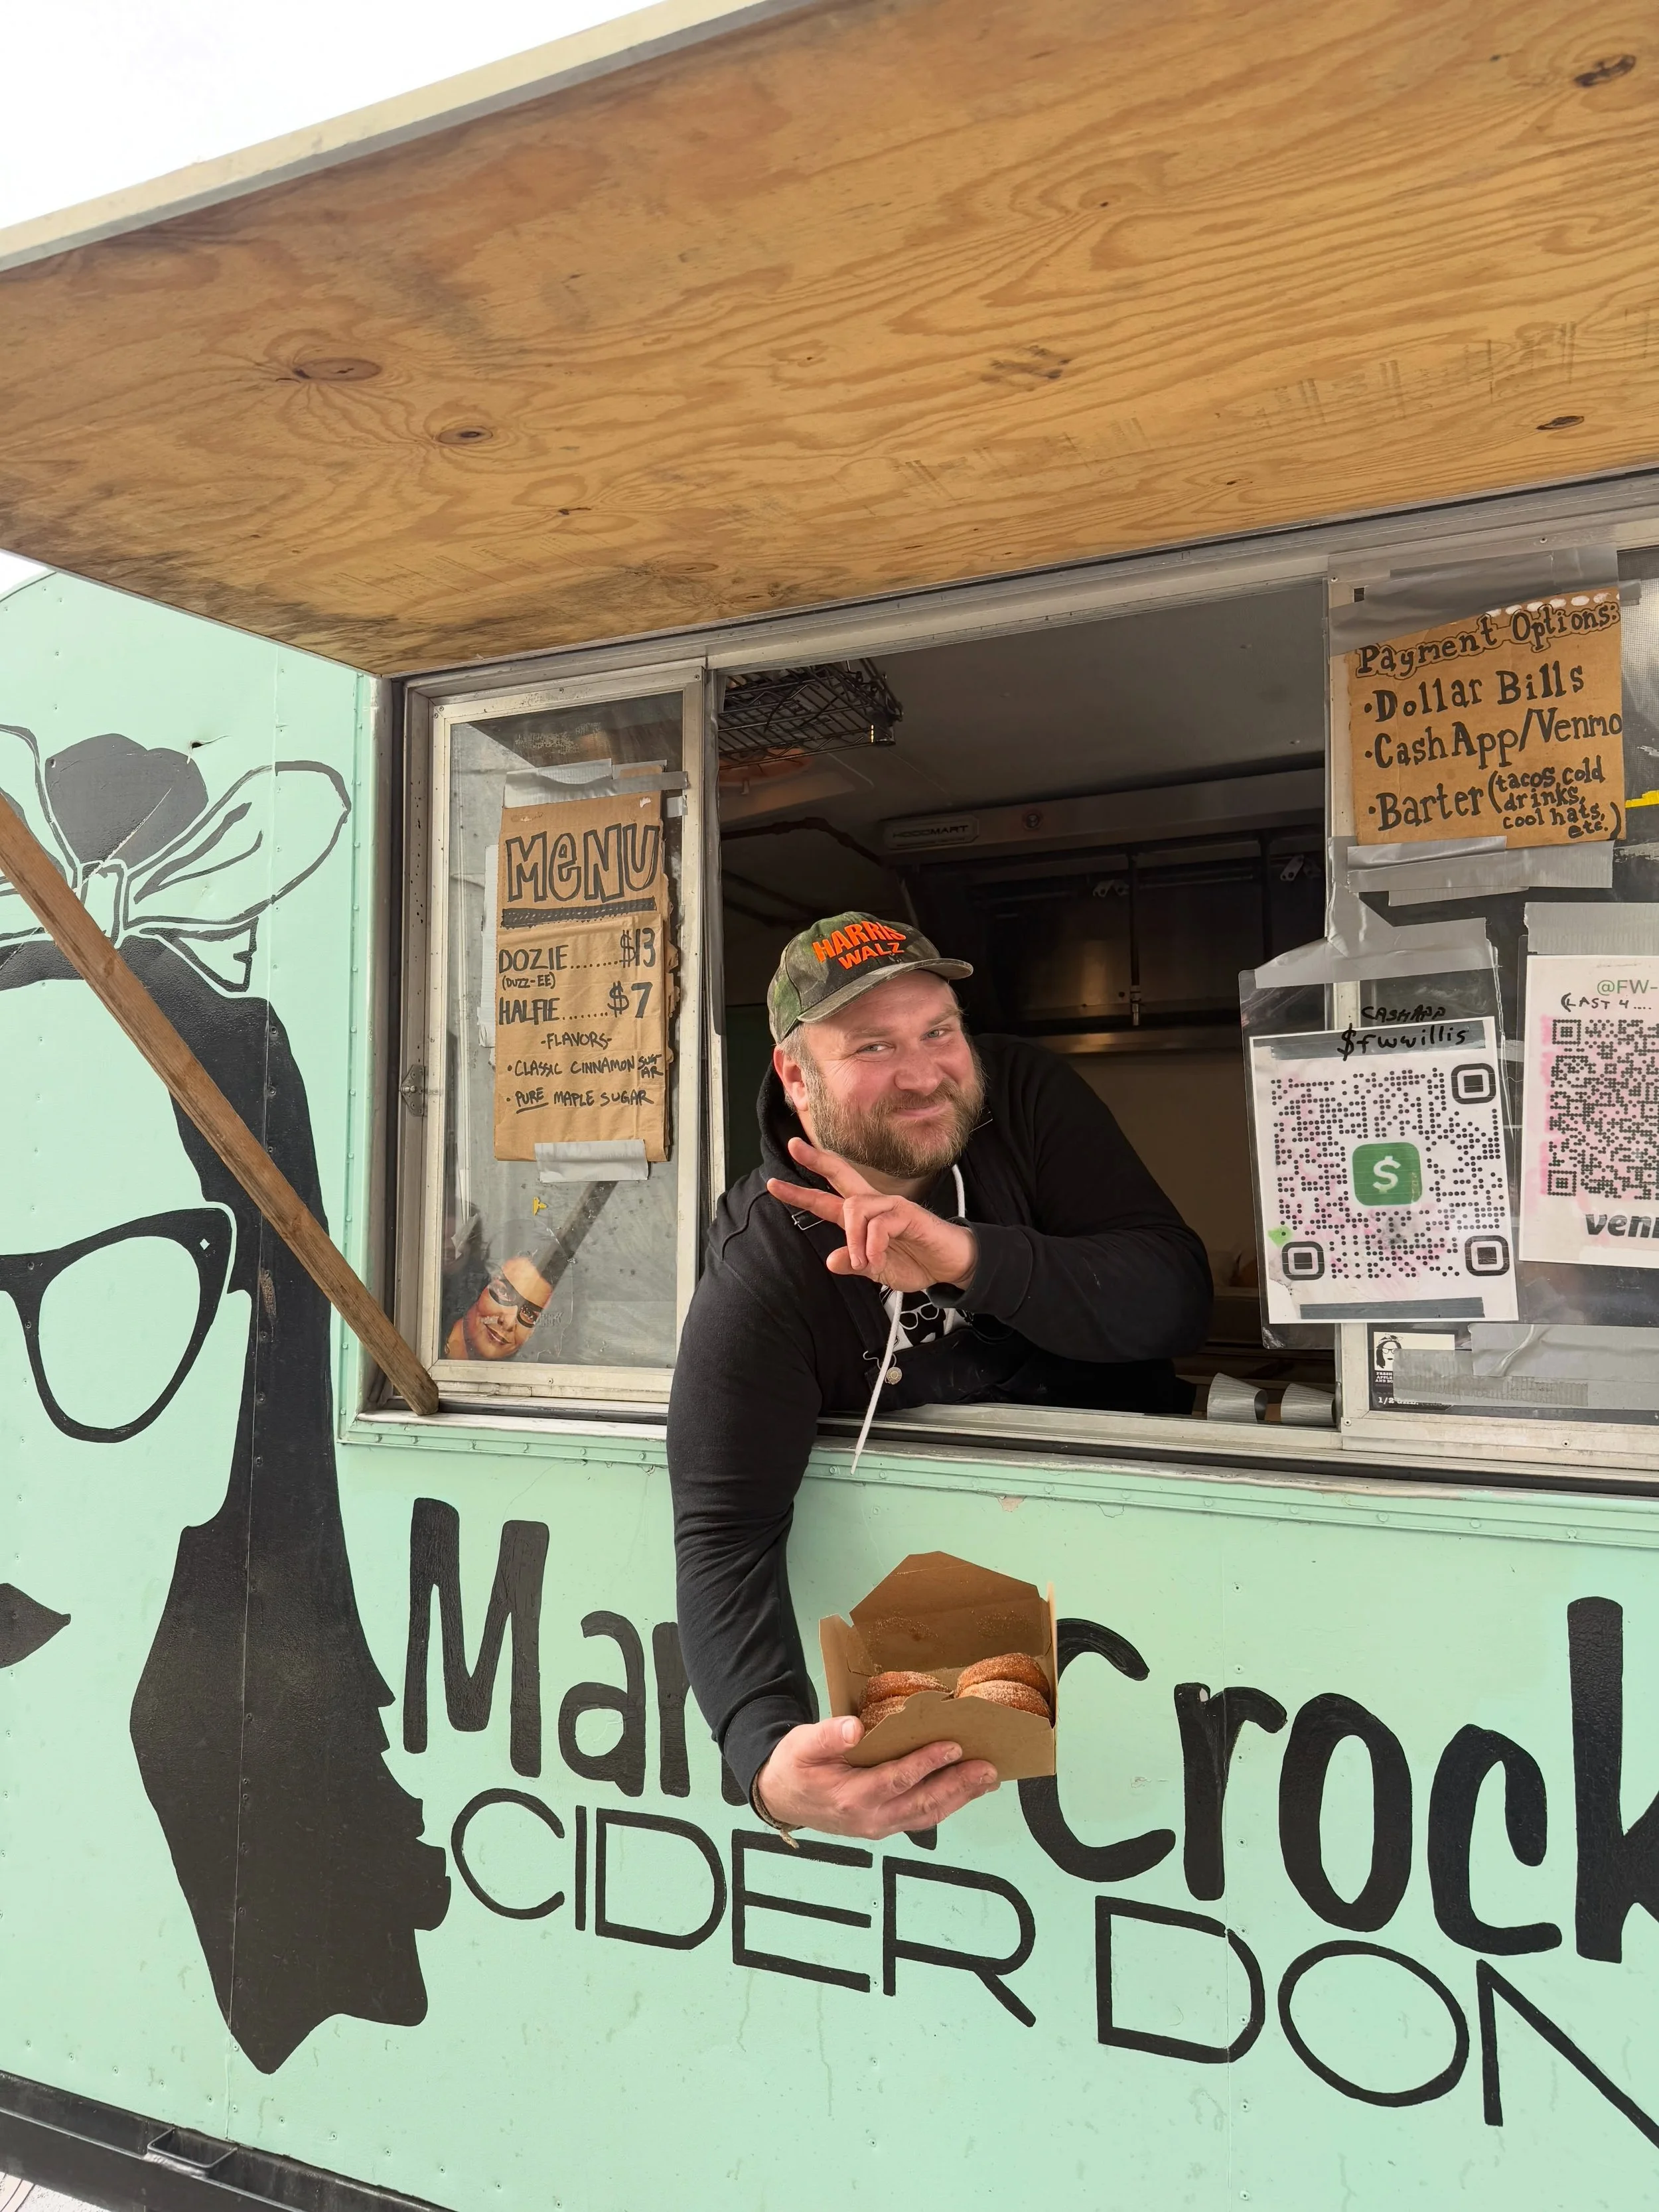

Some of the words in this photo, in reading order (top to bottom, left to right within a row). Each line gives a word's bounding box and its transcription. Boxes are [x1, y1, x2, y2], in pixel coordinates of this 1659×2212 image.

[1357, 614, 1498, 677] Payment
[1511, 603, 1619, 652] Options:
[1373, 678, 1483, 722] Dollar
[1496, 660, 1585, 705] Bills
[1376, 782, 1484, 832] Barter
[1562, 755, 1606, 786] cold
[1504, 787, 1587, 811] drinks,
[1503, 808, 1545, 830] cool
[1550, 800, 1606, 826] hats,
[499, 944, 569, 974] DOZIE
[620, 927, 656, 968] $13
[812, 921, 906, 962] HARRIS
[838, 942, 904, 970] WALZ
[502, 971, 556, 990] (DUZZ-EE)
[1597, 980, 1658, 996] @FW-
[499, 997, 560, 1025] HALFIE
[1561, 992, 1611, 1013] (LAST
[514, 1059, 563, 1077] CLASSIC
[570, 1055, 635, 1074] CINNAMON
[641, 1065, 664, 1078] AR
[515, 1086, 544, 1107] PURE
[553, 1090, 595, 1107] MAPLE
[600, 1088, 655, 1107] SUGAR
[1585, 1214, 1659, 1238] ven
[451, 1787, 1038, 2028] CIDER
